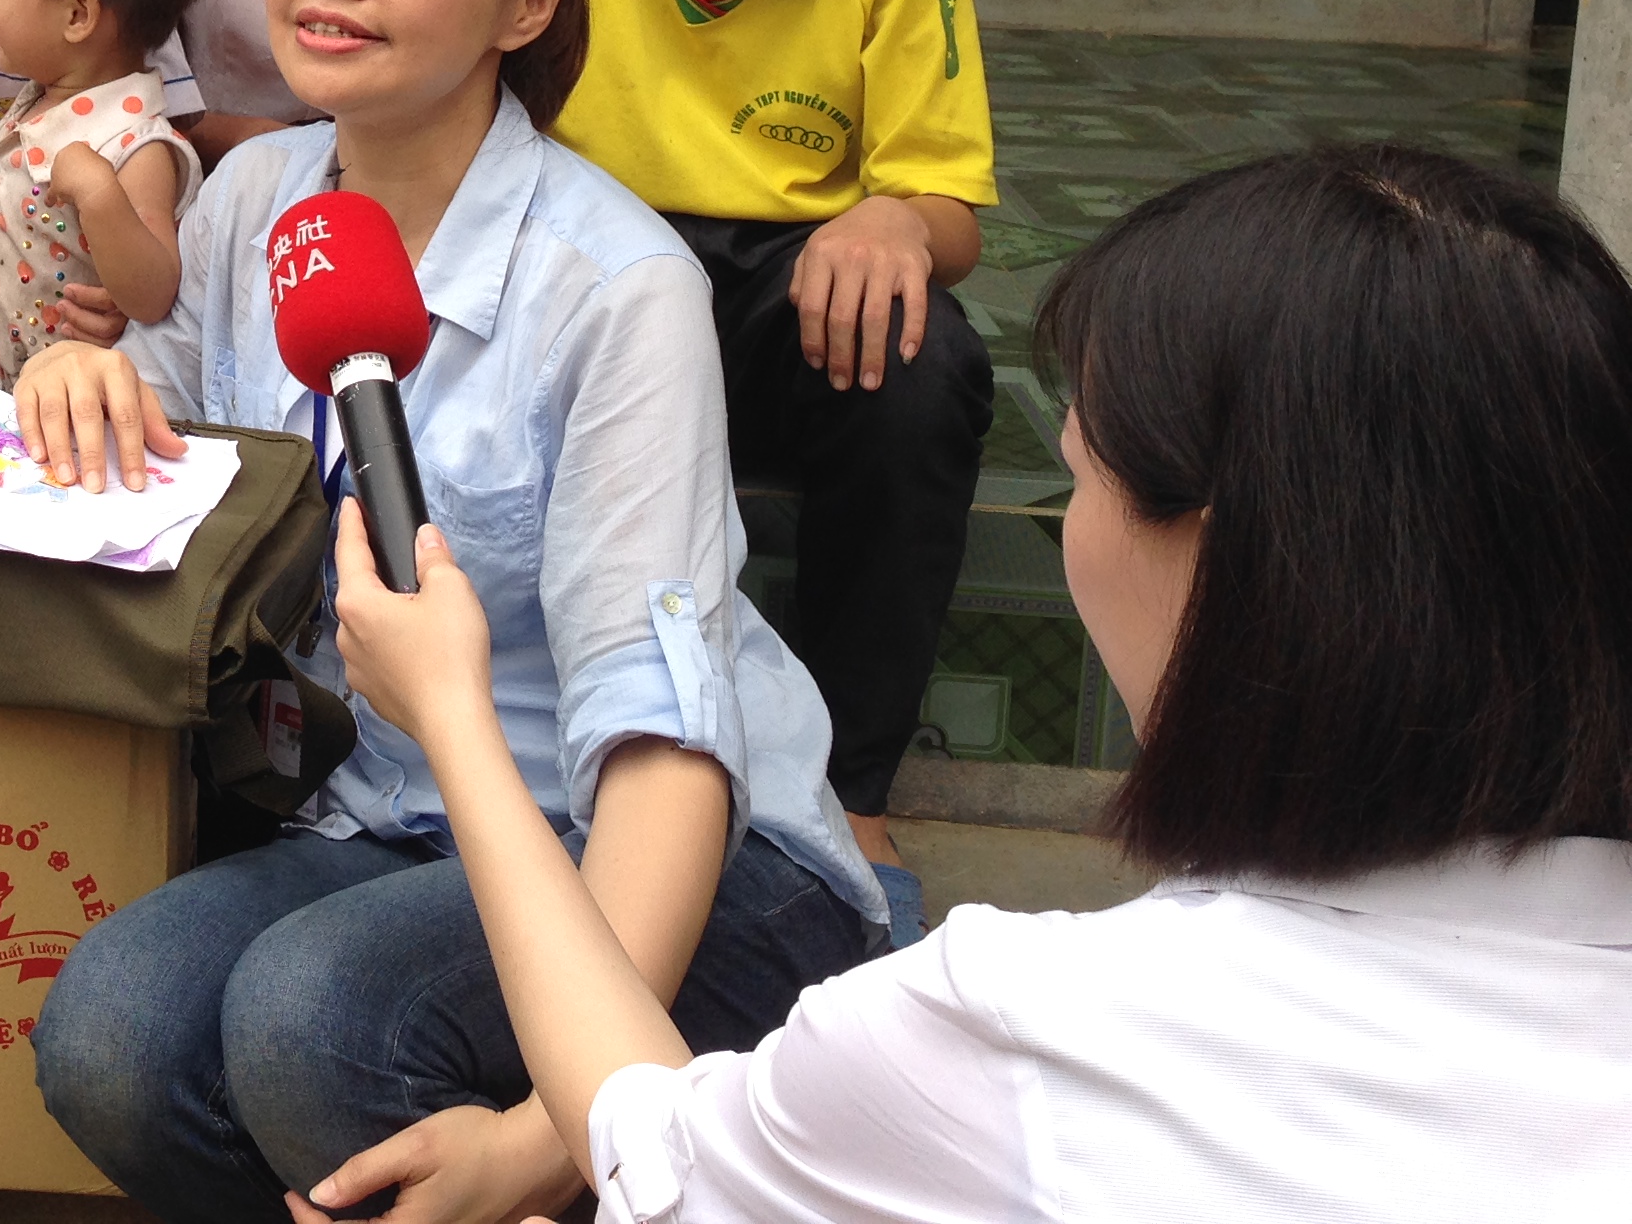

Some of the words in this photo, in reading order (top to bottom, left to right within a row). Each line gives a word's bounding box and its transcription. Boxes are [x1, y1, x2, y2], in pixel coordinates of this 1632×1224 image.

[755, 90, 780, 108] THPT
[269, 214, 332, 271] 央社
[270, 248, 335, 322] NA
[30, 941, 72, 956] lượn
